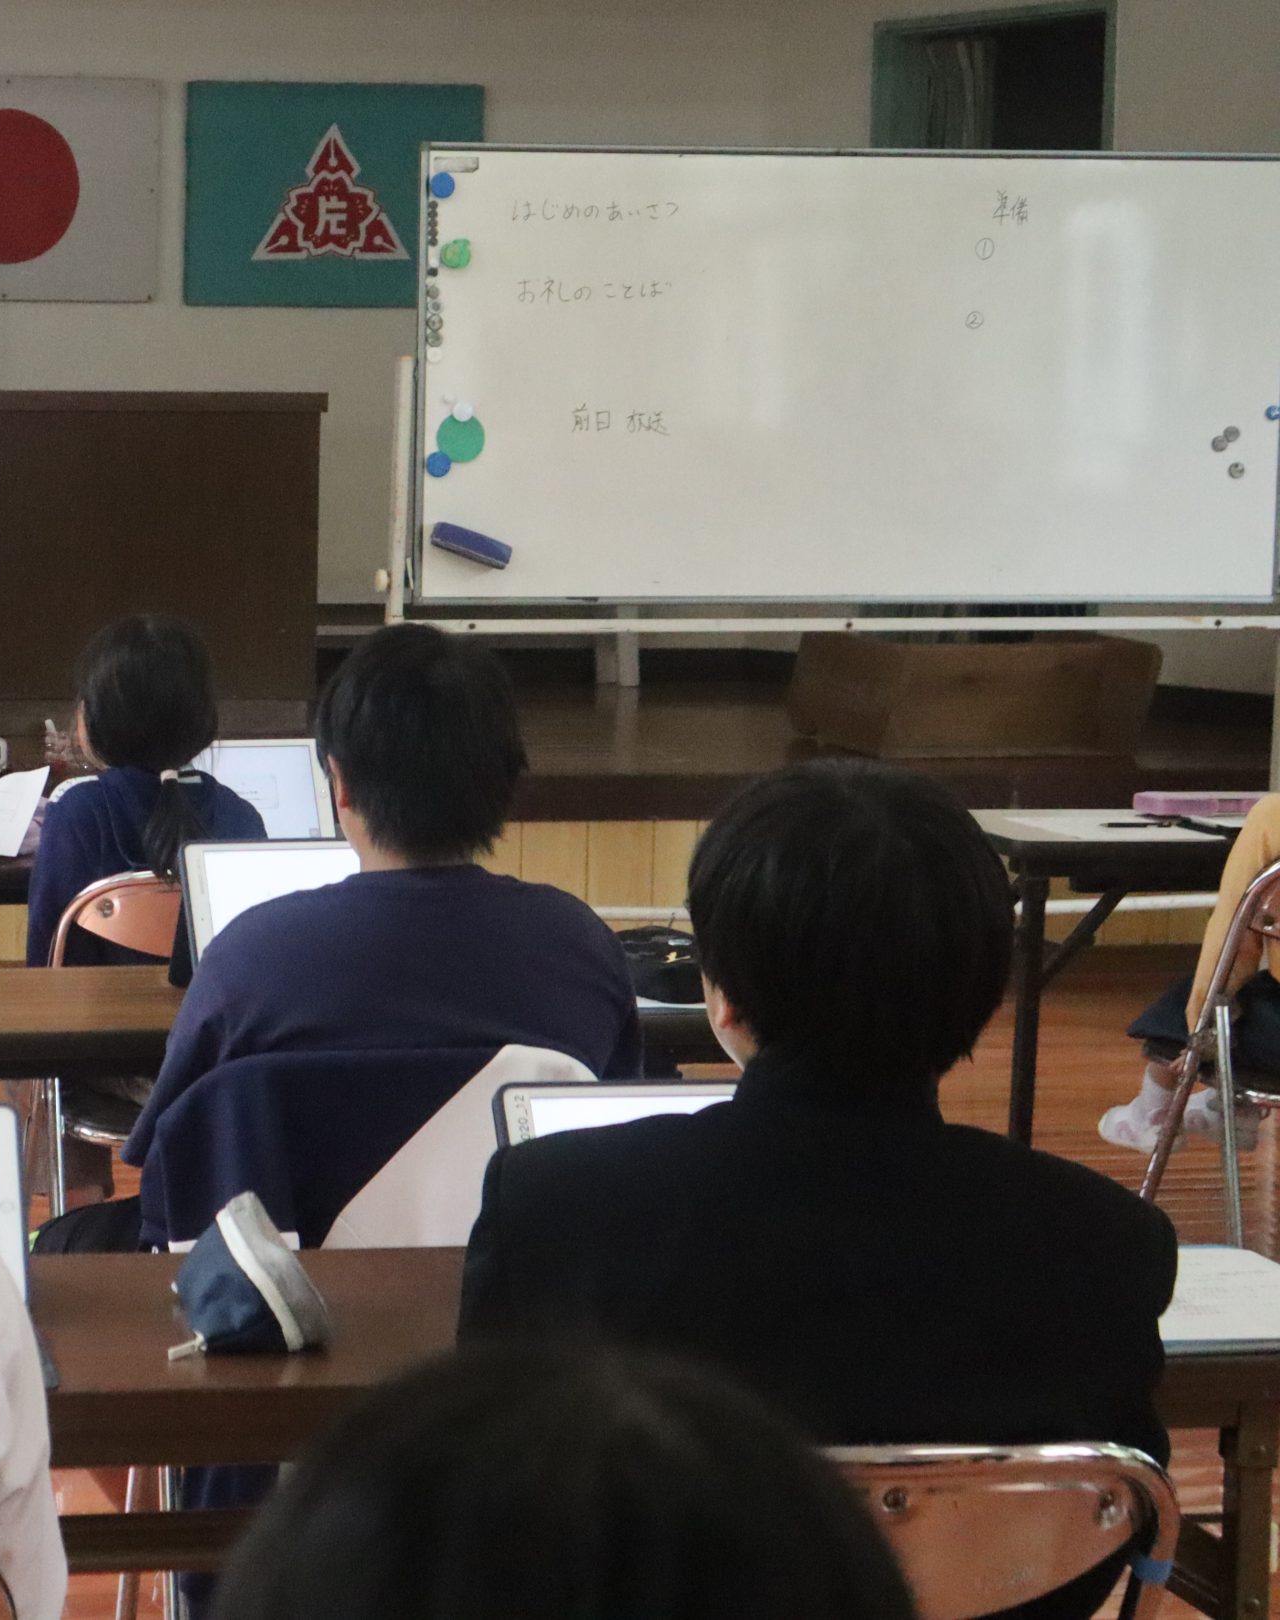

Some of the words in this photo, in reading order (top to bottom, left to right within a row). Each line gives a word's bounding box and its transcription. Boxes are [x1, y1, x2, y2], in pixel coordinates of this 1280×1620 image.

[512, 199, 679, 222] はじめのあいさつ
